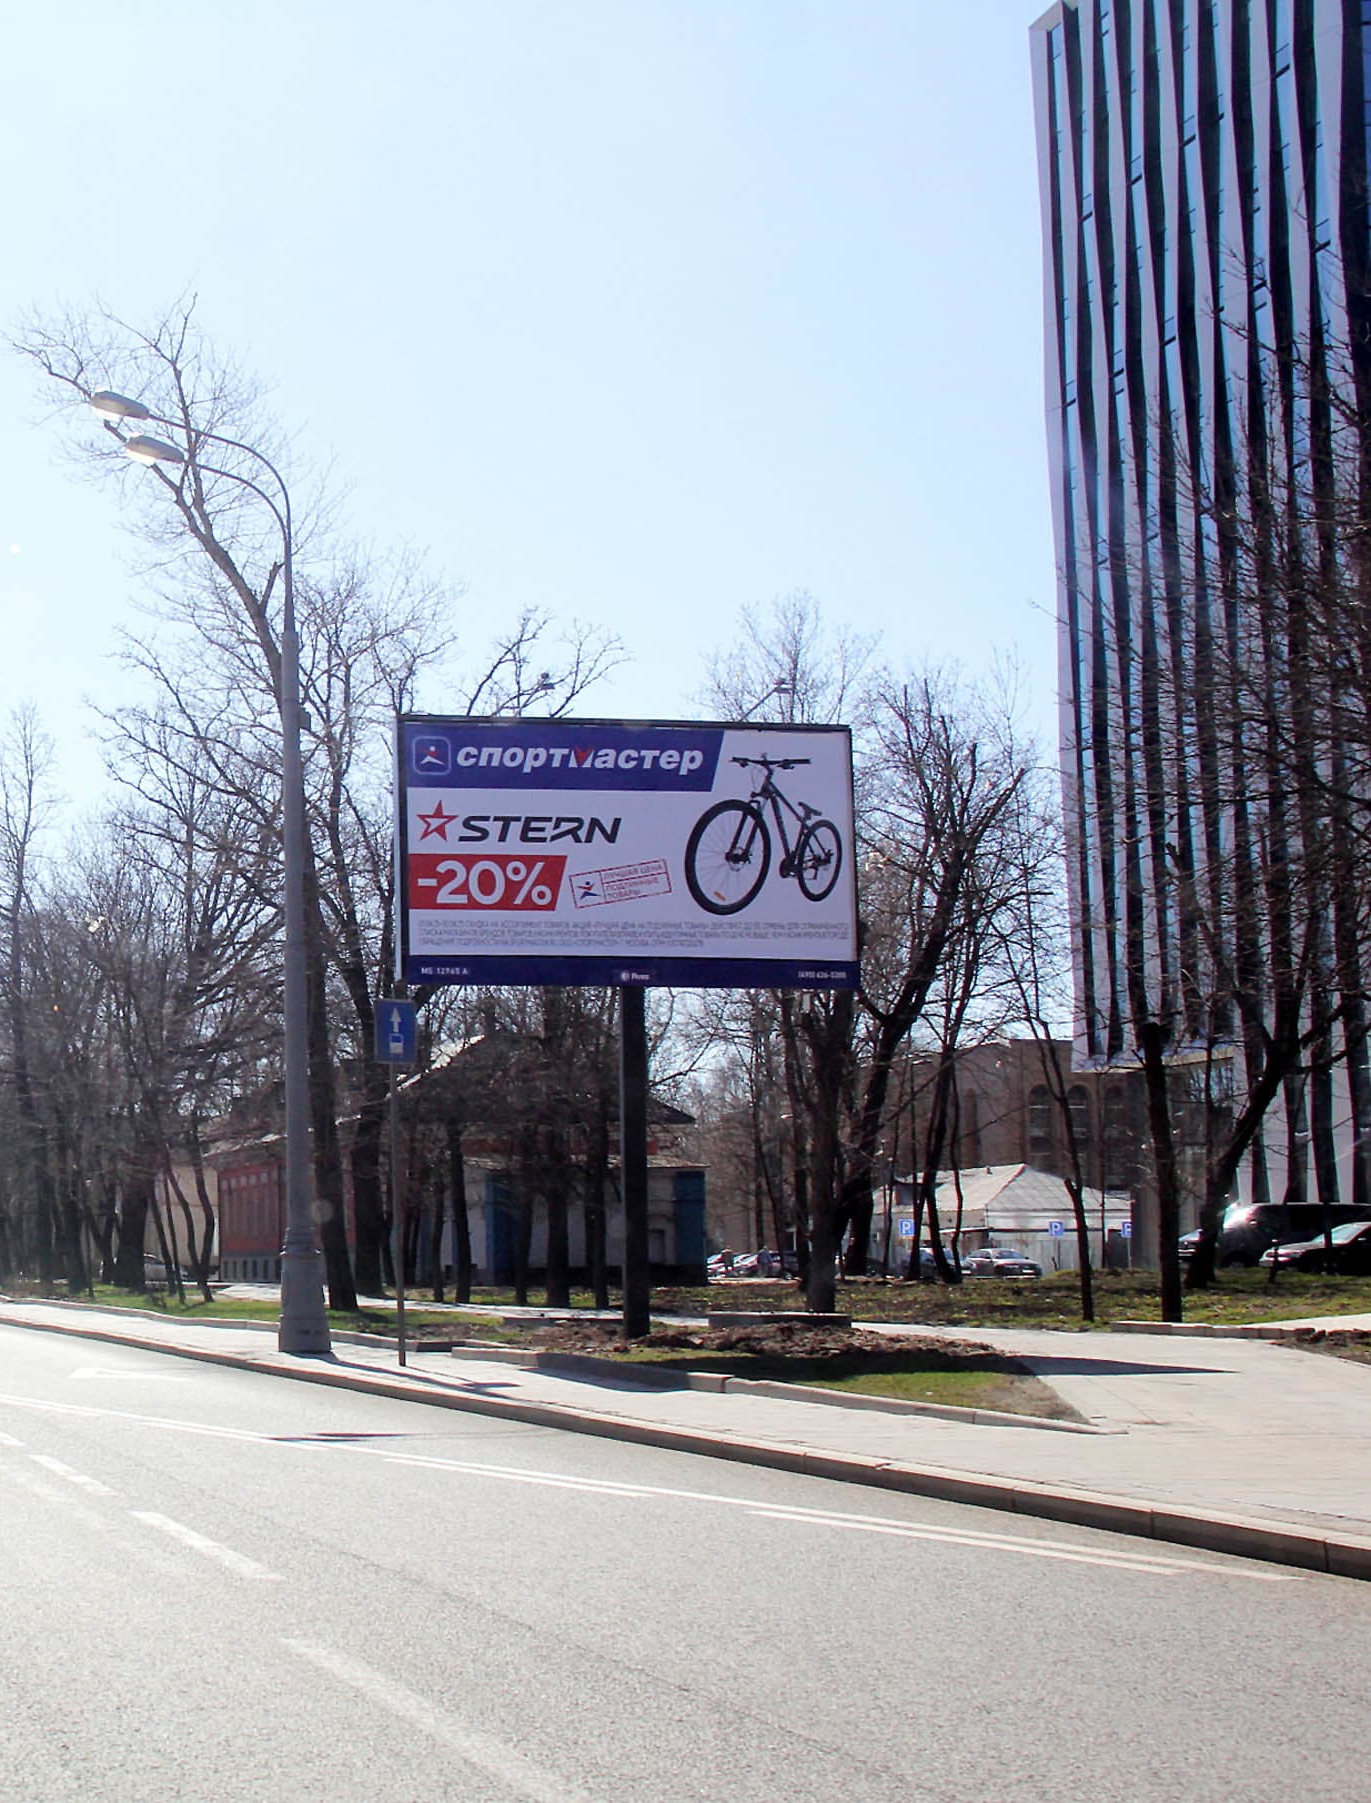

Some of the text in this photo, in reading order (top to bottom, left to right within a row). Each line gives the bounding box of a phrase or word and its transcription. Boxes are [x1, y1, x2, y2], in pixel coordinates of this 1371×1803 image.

[456, 745, 703, 775] спортмастер
[458, 815, 622, 844] STERN
[417, 859, 553, 906] -20%
